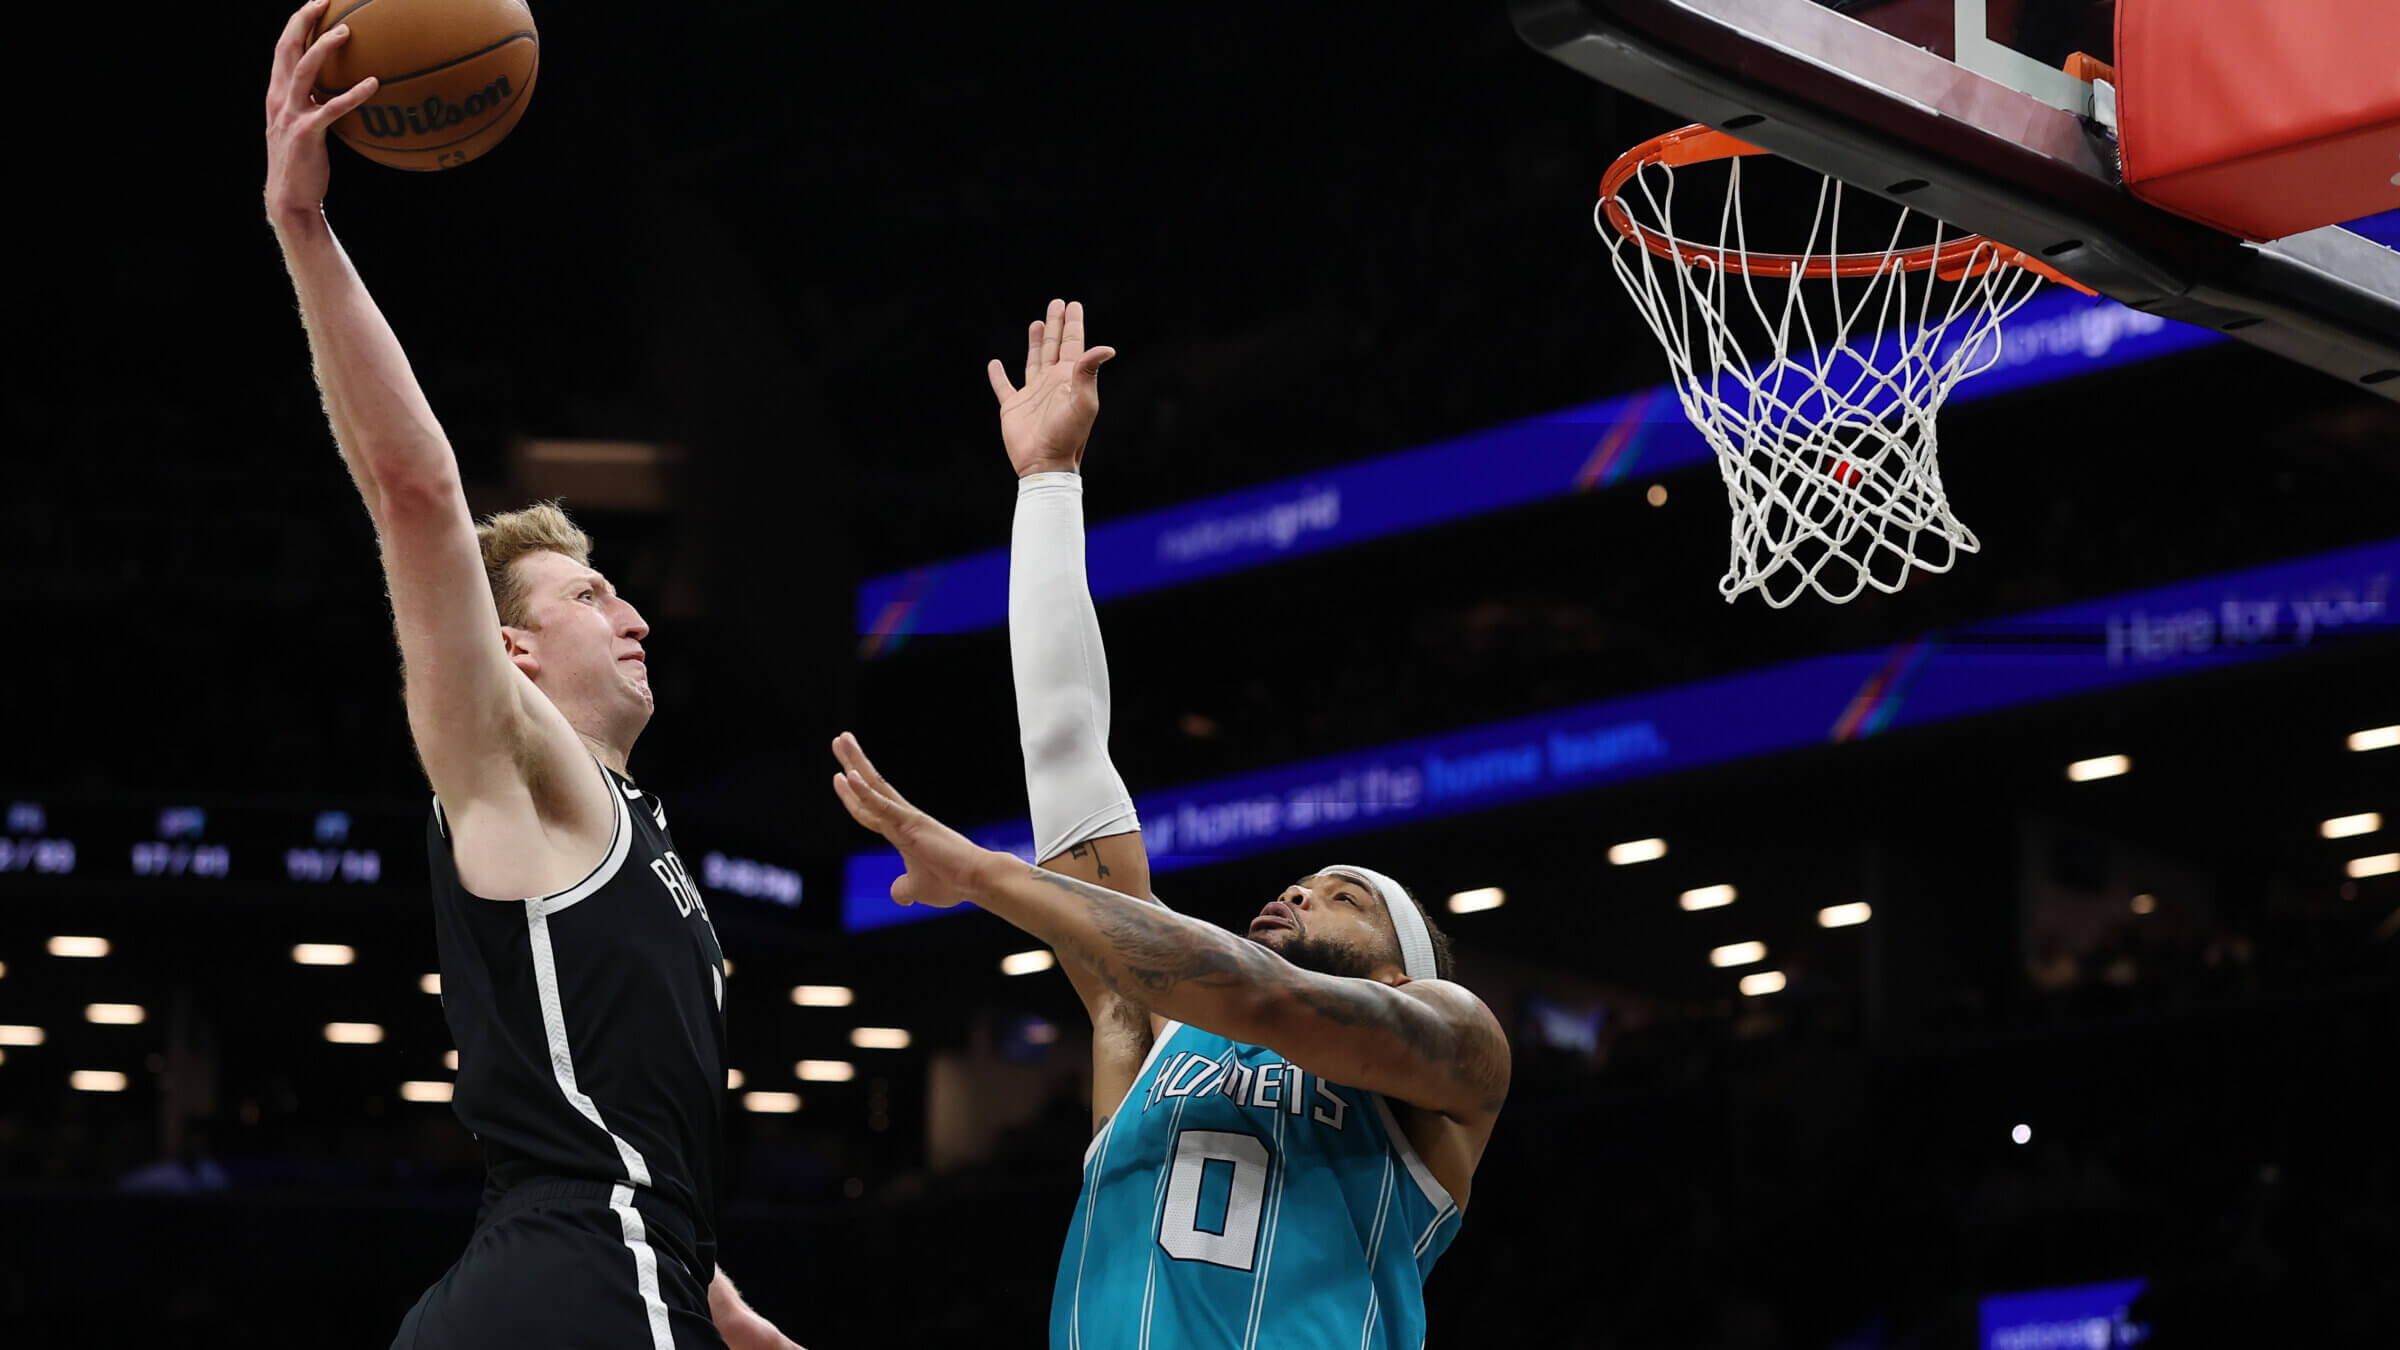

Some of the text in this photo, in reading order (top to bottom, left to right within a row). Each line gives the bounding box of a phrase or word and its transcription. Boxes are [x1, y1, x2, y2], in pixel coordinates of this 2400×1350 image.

[357, 74, 512, 138] Wilson
[2105, 606, 2216, 668] Here
[2220, 592, 2279, 647] for
[1176, 796, 1283, 849] home
[1285, 768, 1359, 832] and
[1360, 762, 1424, 817] the
[1142, 1049, 1351, 1131] HORNETS
[1157, 1128, 1270, 1273] 0
